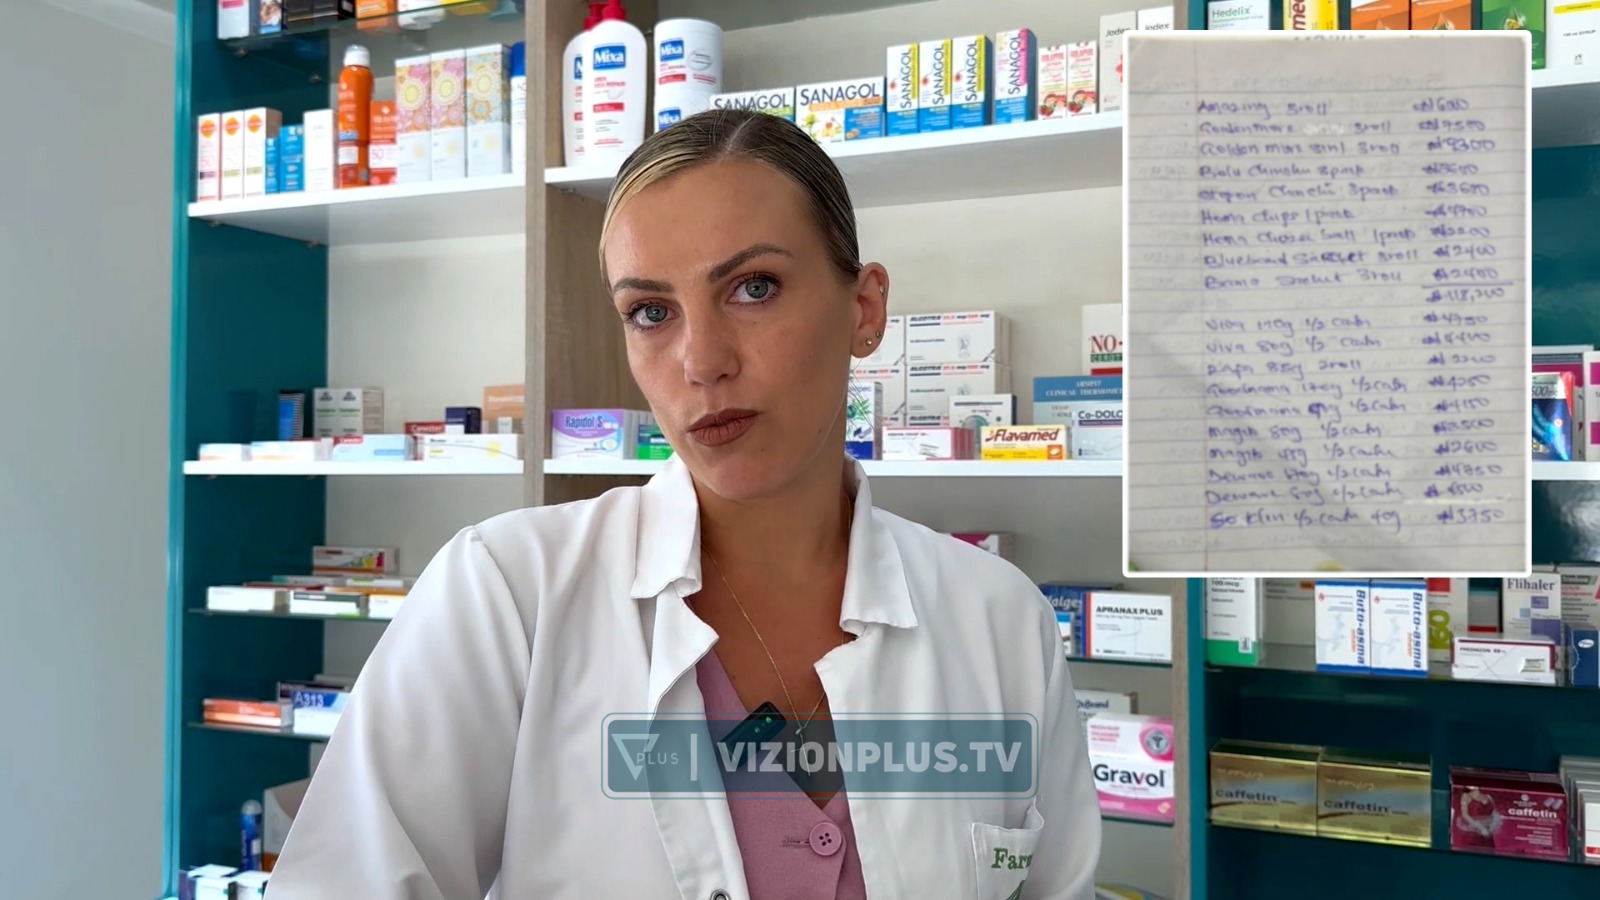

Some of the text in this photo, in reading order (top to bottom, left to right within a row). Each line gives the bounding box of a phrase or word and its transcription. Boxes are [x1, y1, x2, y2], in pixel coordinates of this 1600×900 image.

[1212, 6, 1251, 19] Hedelix
[595, 49, 625, 64] Mixa
[661, 44, 683, 57] Mixa
[965, 40, 978, 101] SANAGOL
[1008, 34, 1021, 95] SANAGOL
[900, 48, 912, 109] SANAGOL
[932, 44, 945, 105] SANAGOL
[714, 93, 791, 110] SANAGOL
[800, 83, 880, 106] SANAGOL
[1045, 389, 1077, 397] CLINICAL
[566, 416, 595, 429] Rapidol
[994, 428, 1059, 442] Flavamed
[1507, 578, 1556, 591] Flihaler
[1096, 605, 1163, 616] APRANAX PLUS
[1356, 589, 1366, 664] Buto-asma
[1412, 592, 1423, 668] Buto-asma
[294, 690, 325, 708] A313
[1093, 763, 1165, 787] Gravol
[1215, 788, 1278, 802] caffetin
[1324, 799, 1389, 813] caffetin
[1508, 807, 1558, 819] caffetin
